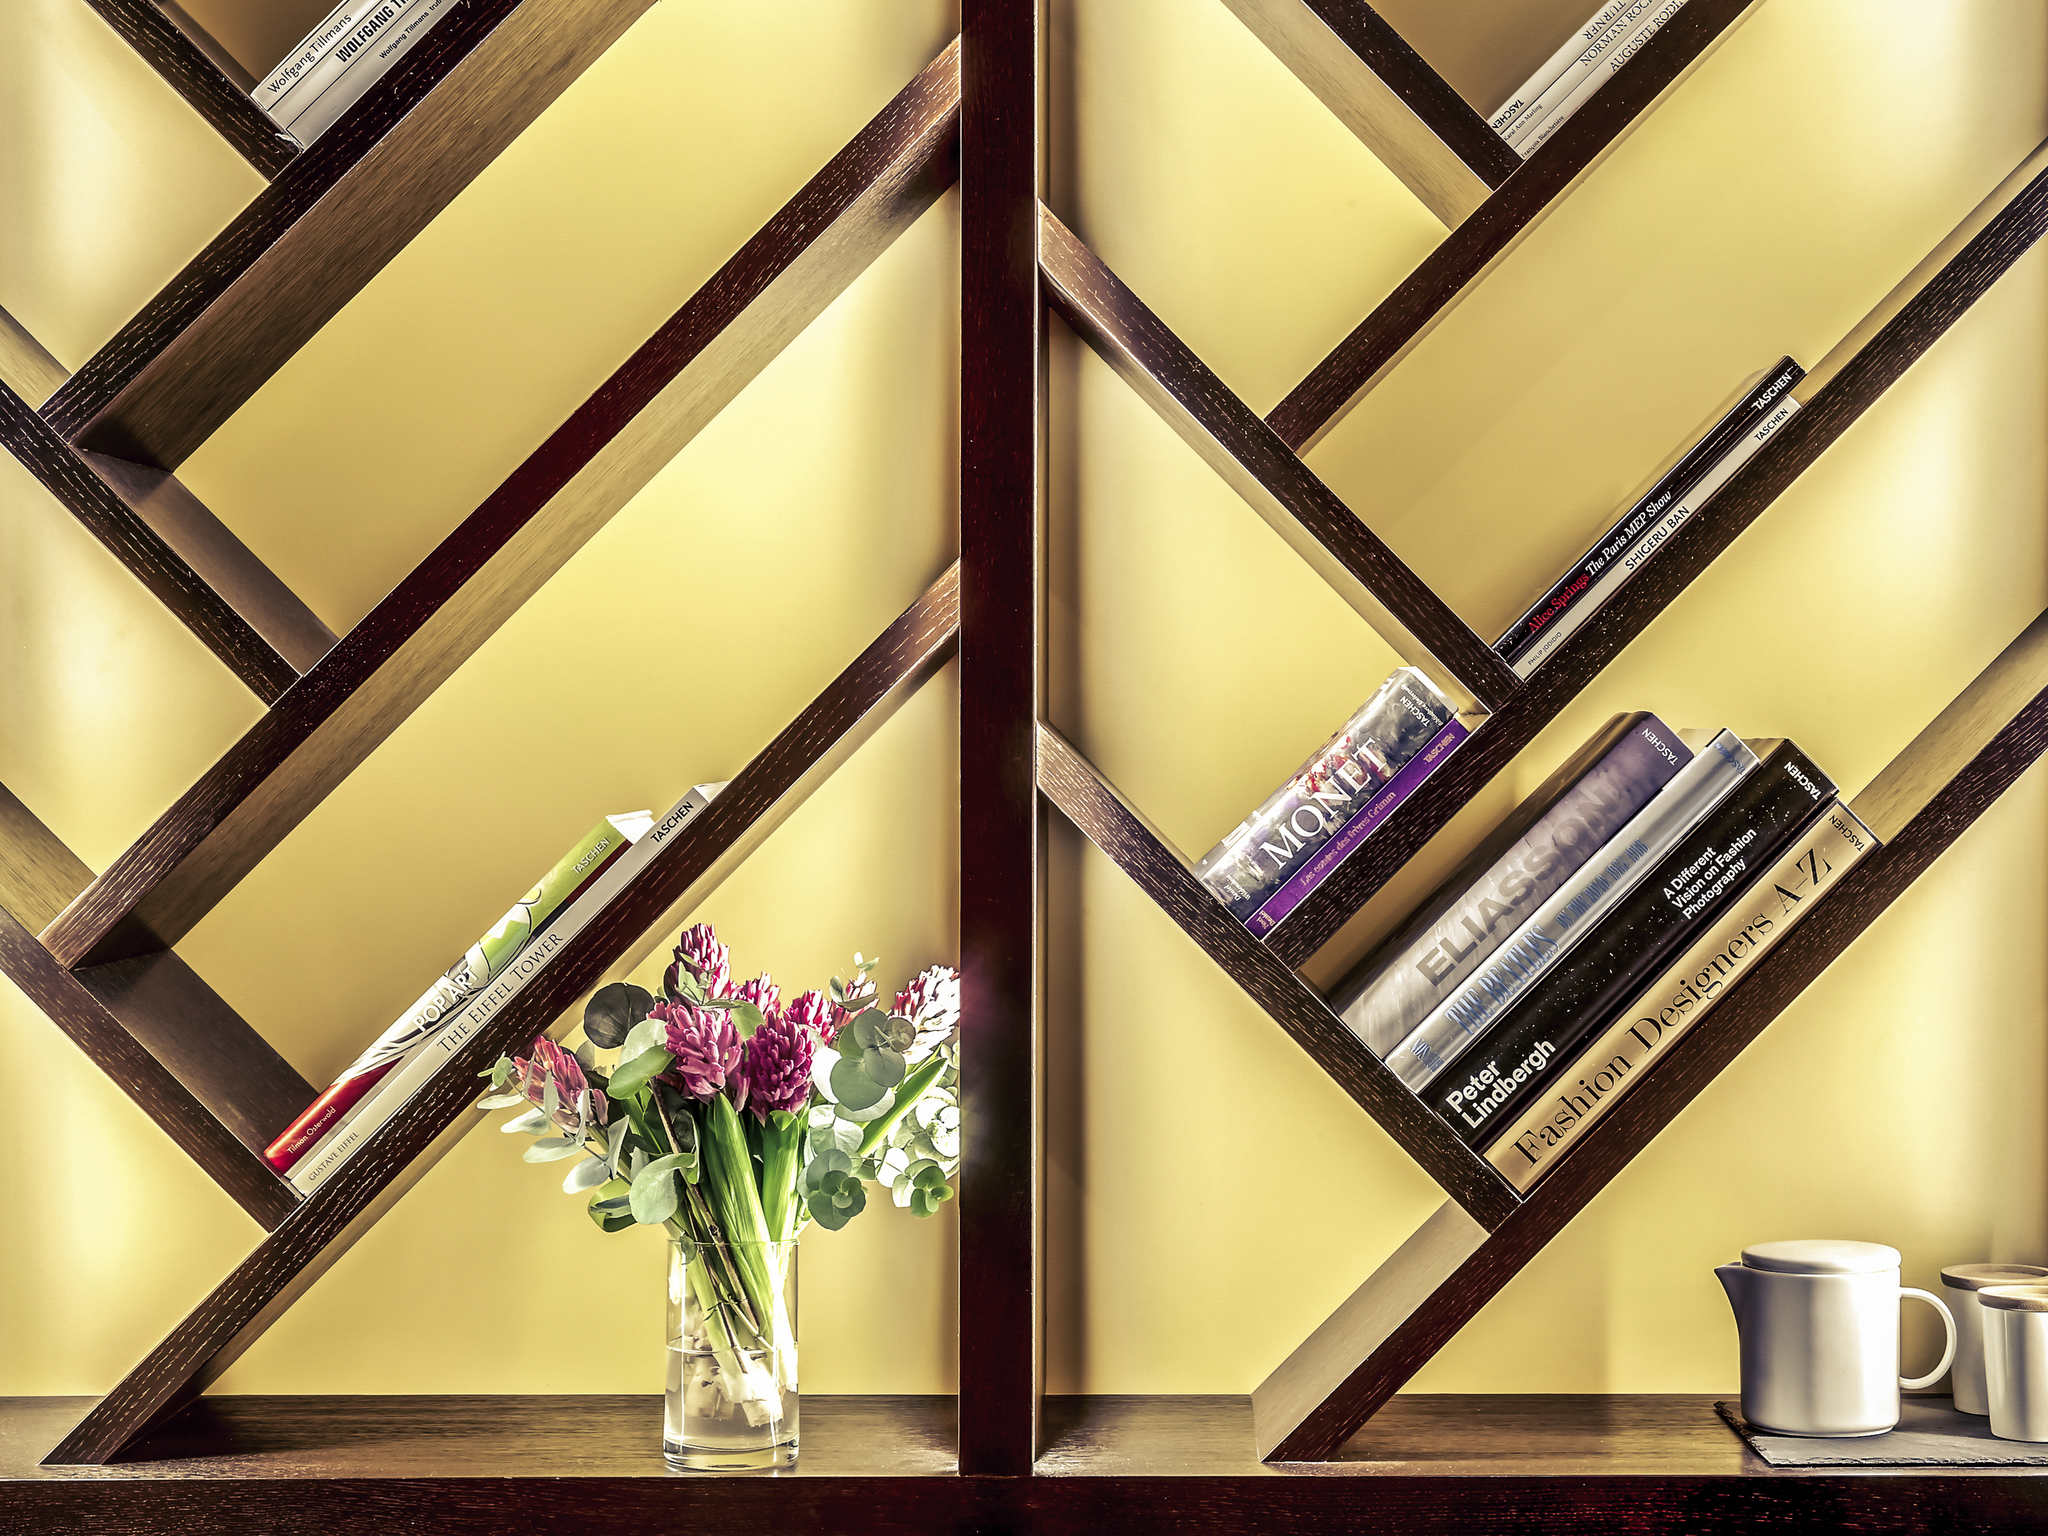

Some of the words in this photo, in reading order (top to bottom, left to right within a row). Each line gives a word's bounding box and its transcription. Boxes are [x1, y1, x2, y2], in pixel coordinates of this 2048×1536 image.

[334, 3, 396, 64] WOLFGANG
[378, 31, 407, 60] Wolfgang
[403, 9, 429, 35] Tillmans
[1579, 19, 1628, 67] NORMAN
[1625, 0, 1652, 22] ROC
[1581, 0, 1627, 41] TURNER
[1607, 23, 1656, 72] AUGUSTE
[266, 48, 316, 97] Wolfgang
[308, 11, 352, 54] Tillmans
[1752, 371, 1793, 411] TASCHEN
[1753, 407, 1789, 442] TASCHEN
[1525, 604, 1555, 633] Alice
[1549, 570, 1592, 612] Springs
[1583, 554, 1605, 576] The
[1600, 532, 1628, 560] Paris
[1621, 511, 1650, 539] MEP
[1642, 487, 1674, 518] Show
[1623, 525, 1669, 570] SHIGERU
[1666, 504, 1690, 529] BAN
[1399, 694, 1430, 727] TASCHEN
[1422, 731, 1456, 765] TASCHEN
[1640, 726, 1679, 767] TASCHEN
[1255, 736, 1394, 870] MONET
[1782, 759, 1823, 801] TASCHEN
[649, 800, 695, 844] TASCHEN
[1297, 868, 1316, 886] Les
[1332, 832, 1352, 851] des
[1365, 788, 1397, 819] Grimm
[1827, 812, 1866, 852] TASCHEN
[571, 836, 612, 875] TASCHEN
[1661, 884, 1676, 899] A
[1669, 845, 1717, 891] Different
[1671, 875, 1706, 910] Vision
[1701, 863, 1720, 882] on
[1714, 825, 1758, 868] Fashion
[1413, 786, 1622, 987] ELIASSON
[1680, 855, 1750, 922] Photography
[410, 992, 452, 1032] POP
[441, 964, 481, 1003] ART
[435, 1020, 471, 1055] THE
[467, 978, 514, 1024] EIFFEL
[509, 929, 564, 983] TOWER
[1443, 986, 1496, 1039] THE
[1507, 1044, 1637, 1169] Fashion
[1624, 906, 1783, 1059] Designers
[1445, 1056, 1504, 1113] Peter
[1460, 1035, 1560, 1131] Lindbergh
[286, 1133, 309, 1154] Tilman
[305, 1105, 337, 1137] Osterwald
[307, 1149, 340, 1181] GUSTAVE
